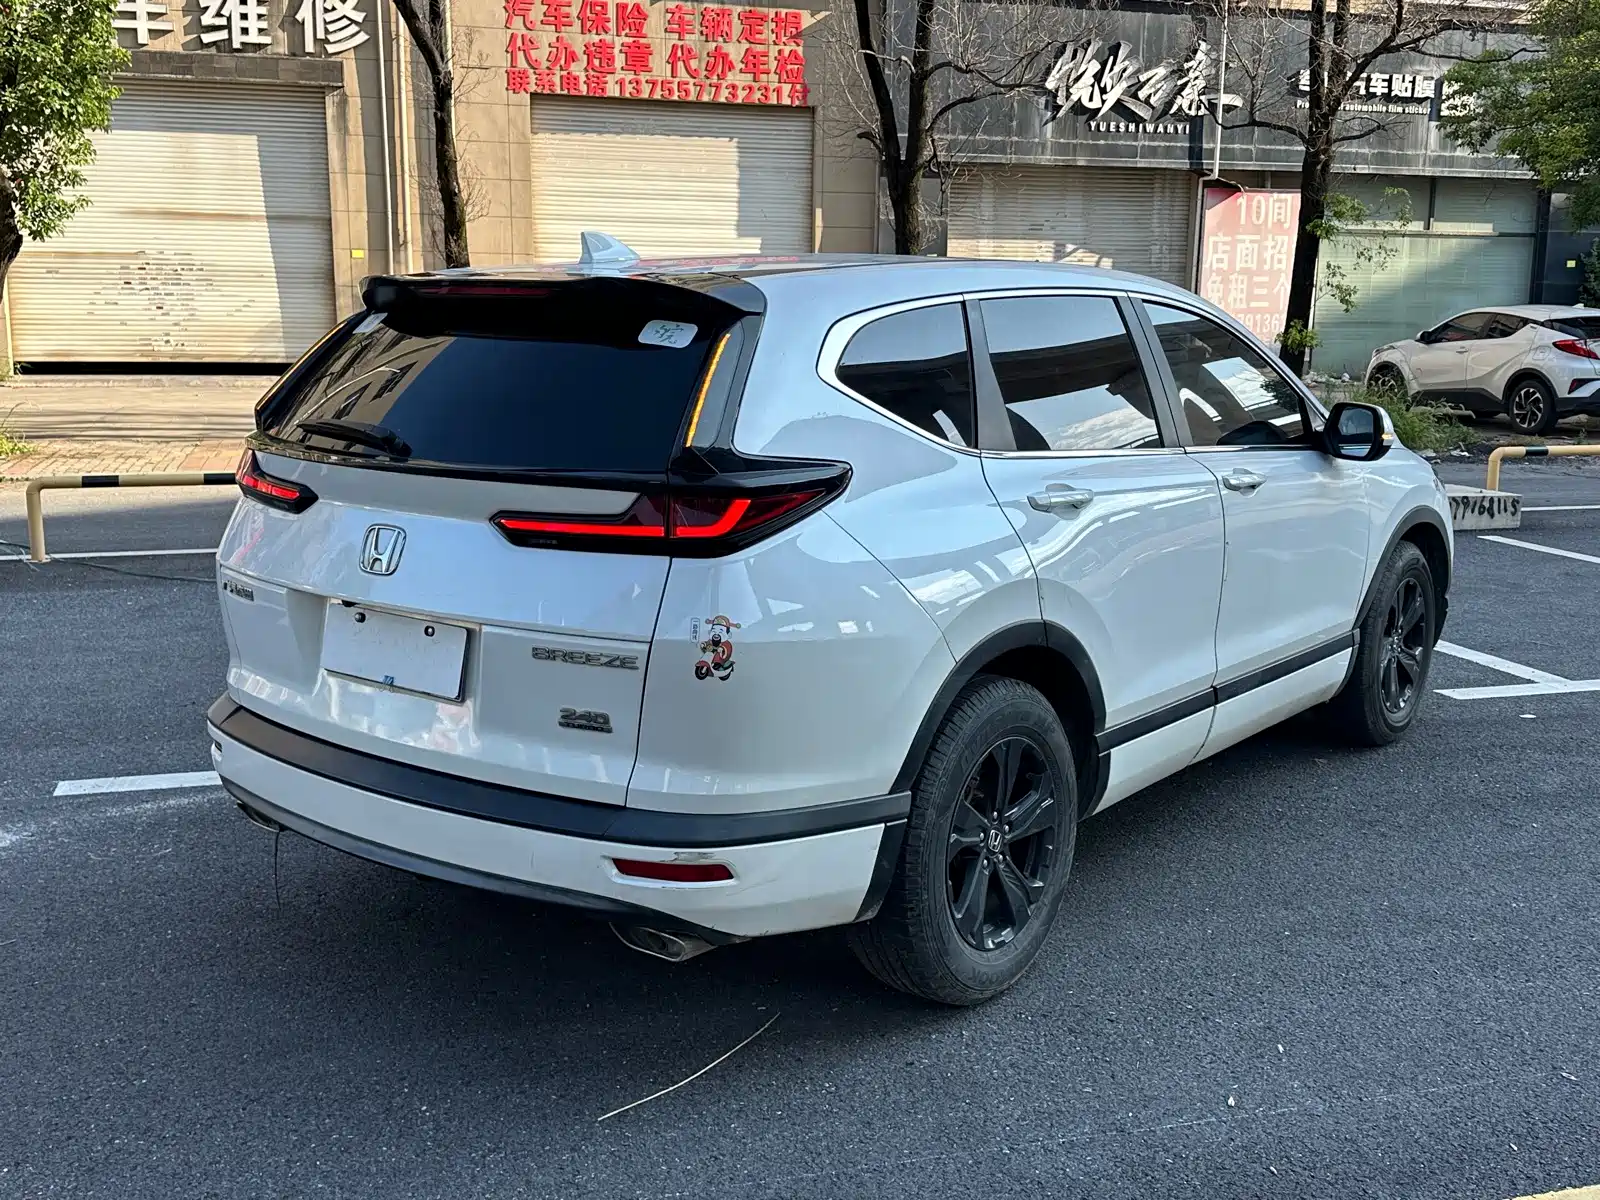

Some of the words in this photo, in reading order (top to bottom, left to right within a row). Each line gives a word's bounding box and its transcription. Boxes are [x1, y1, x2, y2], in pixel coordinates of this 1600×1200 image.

[504, 0, 649, 39] 汽车保险
[666, 2, 804, 46] 车辆定损
[506, 32, 653, 75] 代办违章
[668, 44, 806, 84] 代办年检
[506, 68, 608, 97] 联系电话
[1236, 195, 1293, 229] 10间
[1205, 233, 1295, 271] 店面招
[531, 646, 640, 671] BREEZE
[559, 706, 610, 725] 240
